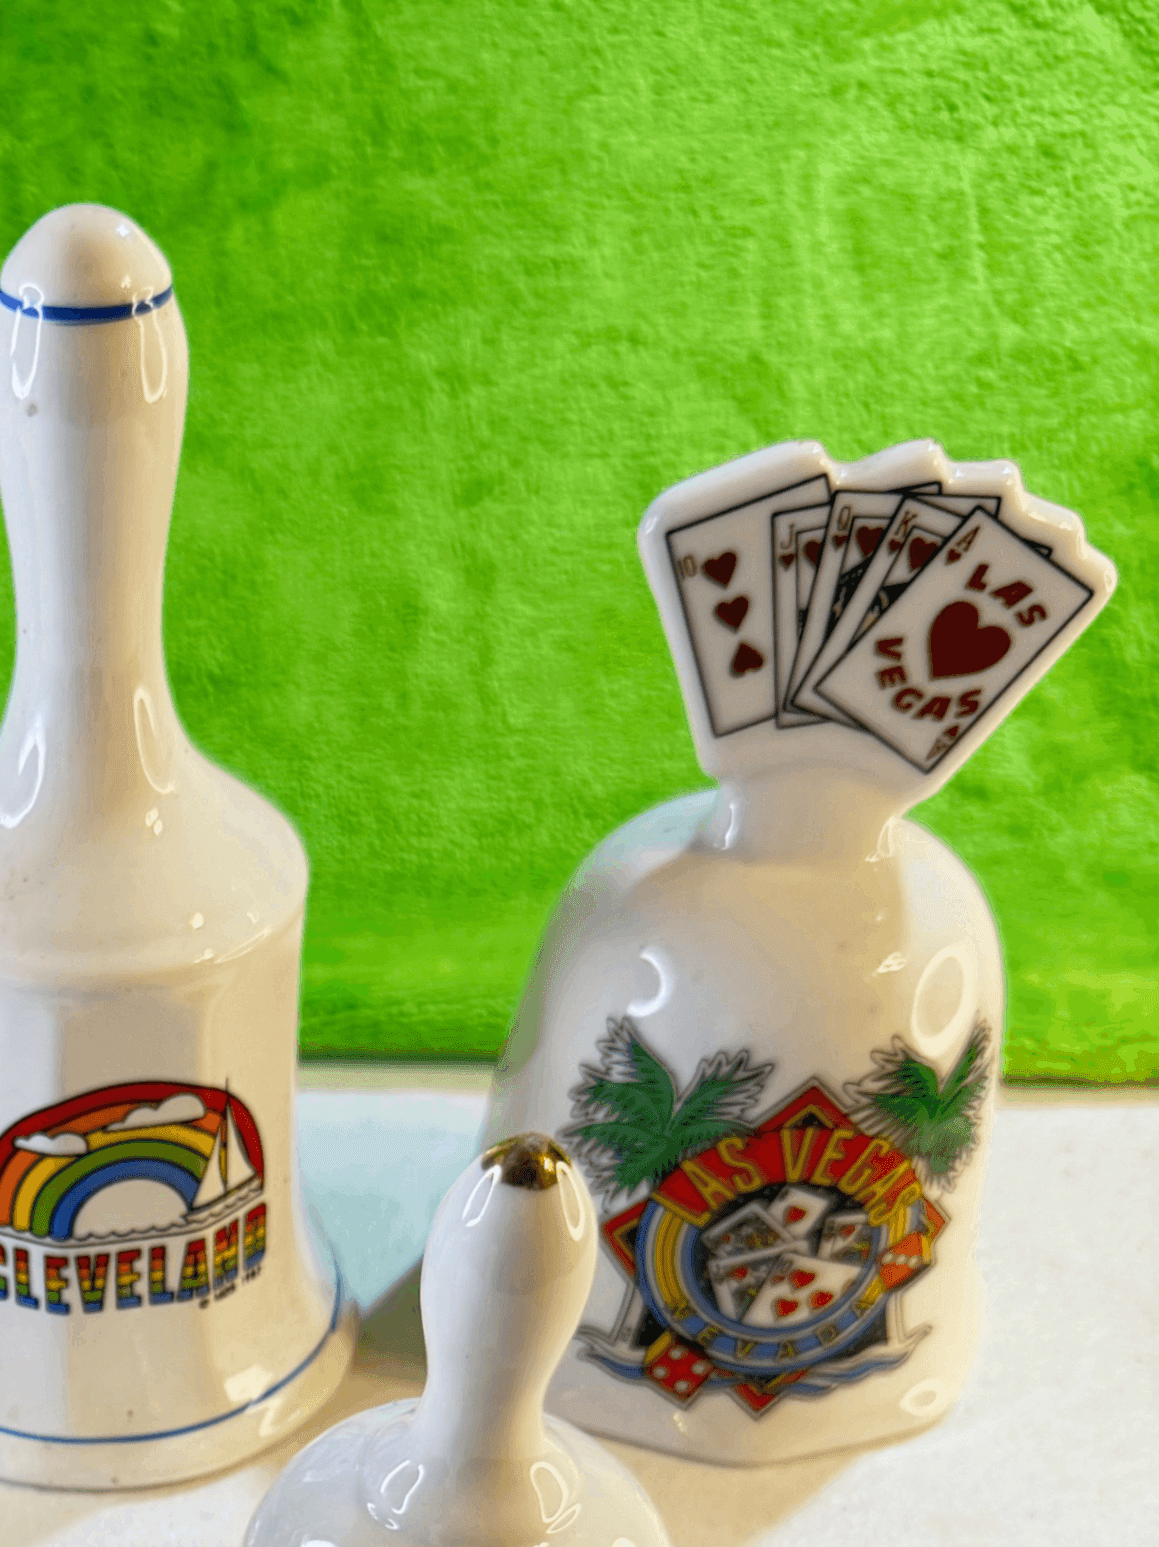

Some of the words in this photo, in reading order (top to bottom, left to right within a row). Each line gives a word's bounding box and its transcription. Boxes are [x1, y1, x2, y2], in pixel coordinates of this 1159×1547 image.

[964, 562, 1050, 628] LAS
[875, 635, 984, 722] VEGAS
[651, 1135, 761, 1228] LAS
[780, 1127, 924, 1228] VEGAS
